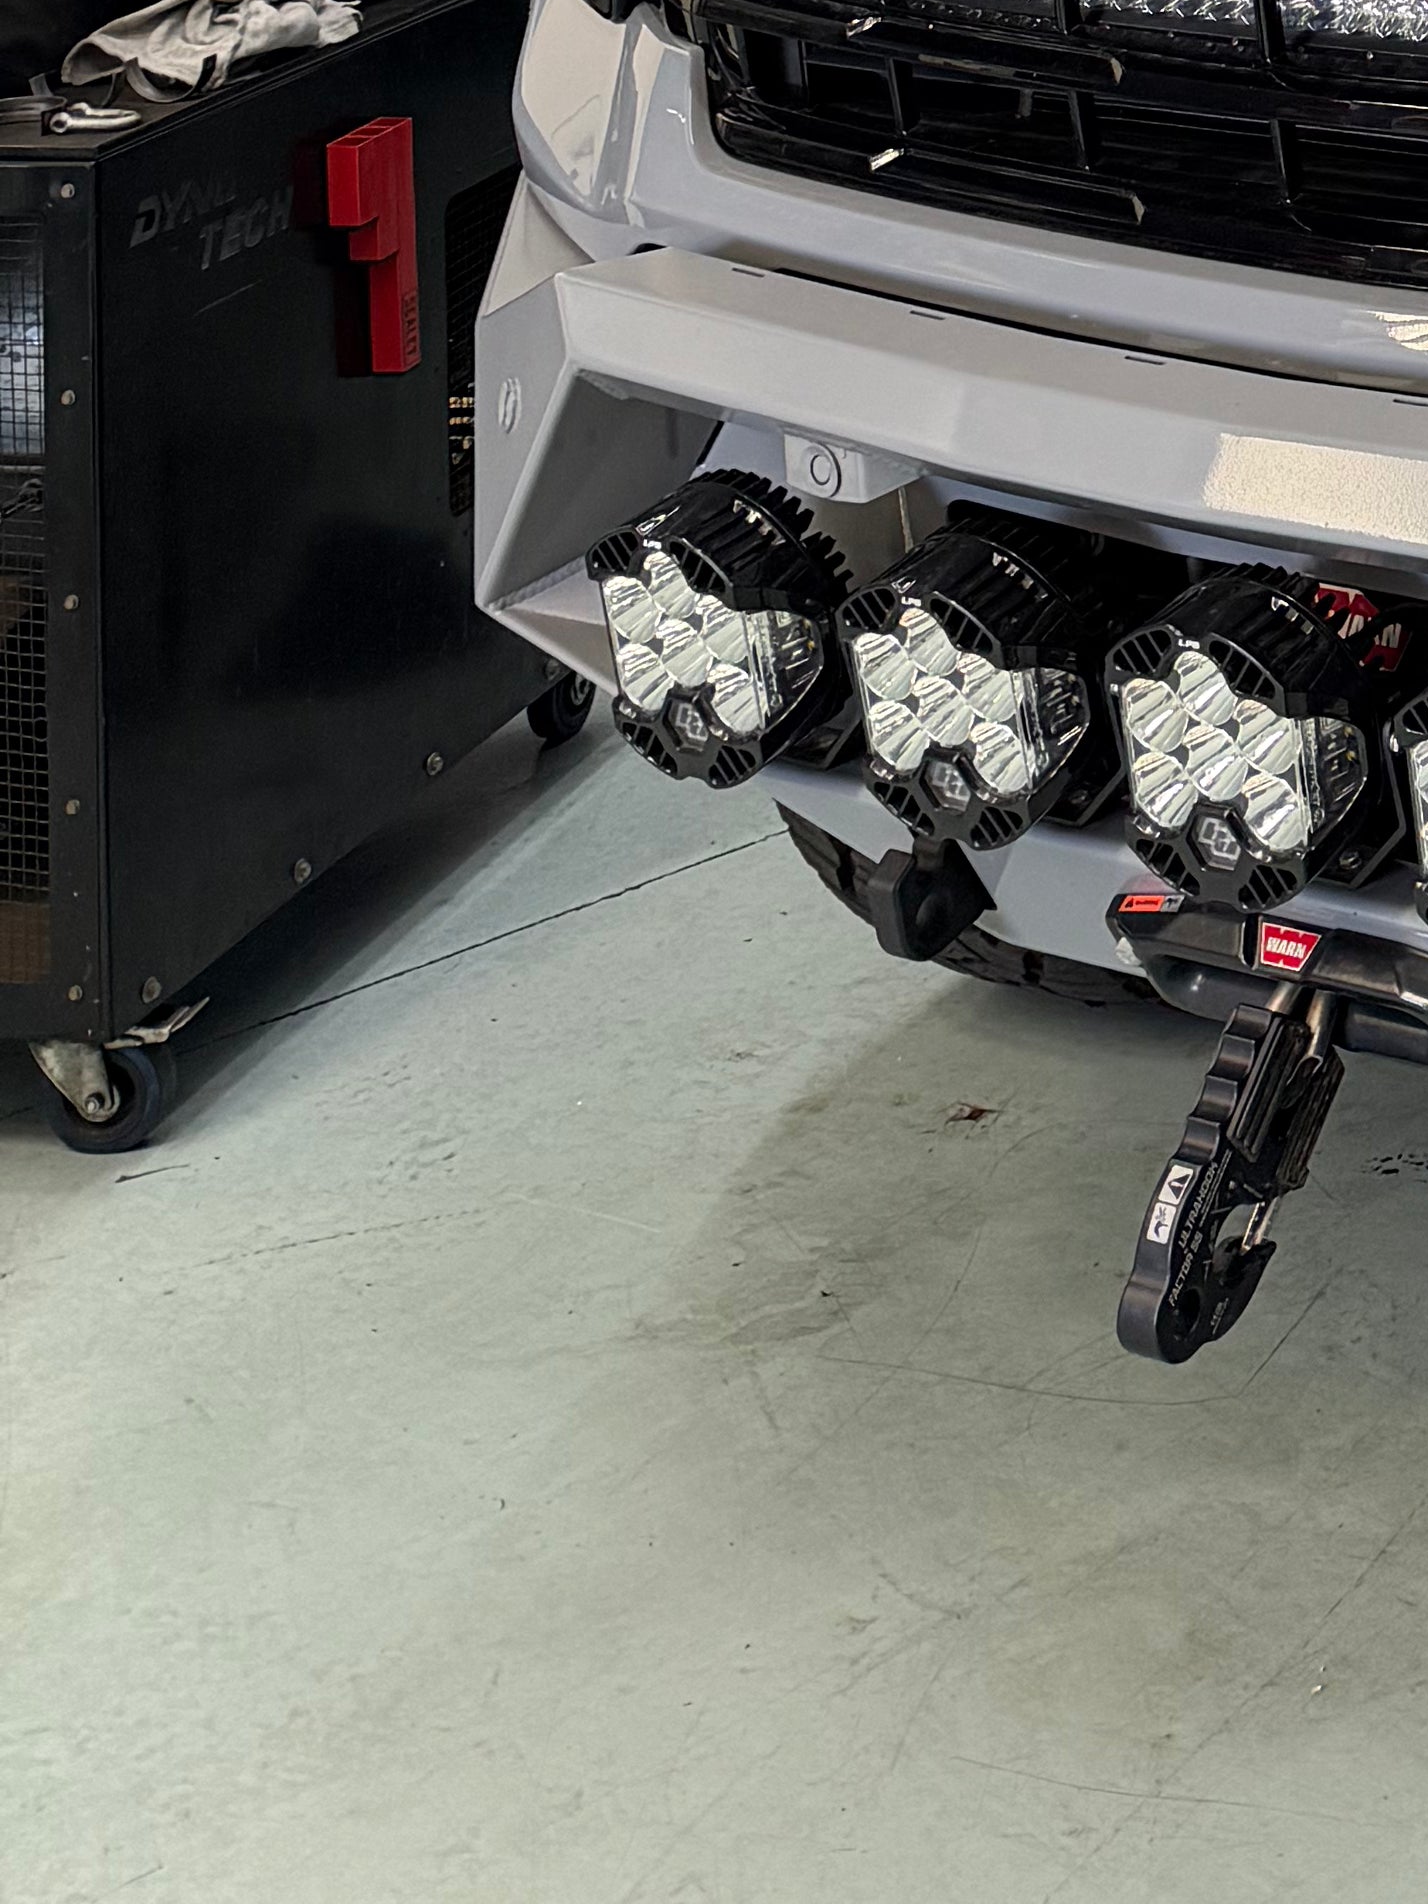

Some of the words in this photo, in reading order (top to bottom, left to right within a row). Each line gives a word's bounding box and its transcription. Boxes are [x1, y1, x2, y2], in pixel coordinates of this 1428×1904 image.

[200, 185, 294, 271] TECH
[1265, 936, 1307, 959] WARN
[1178, 1162, 1219, 1250] ULTRAHOOK
[1168, 1253, 1195, 1307] FACTOR
